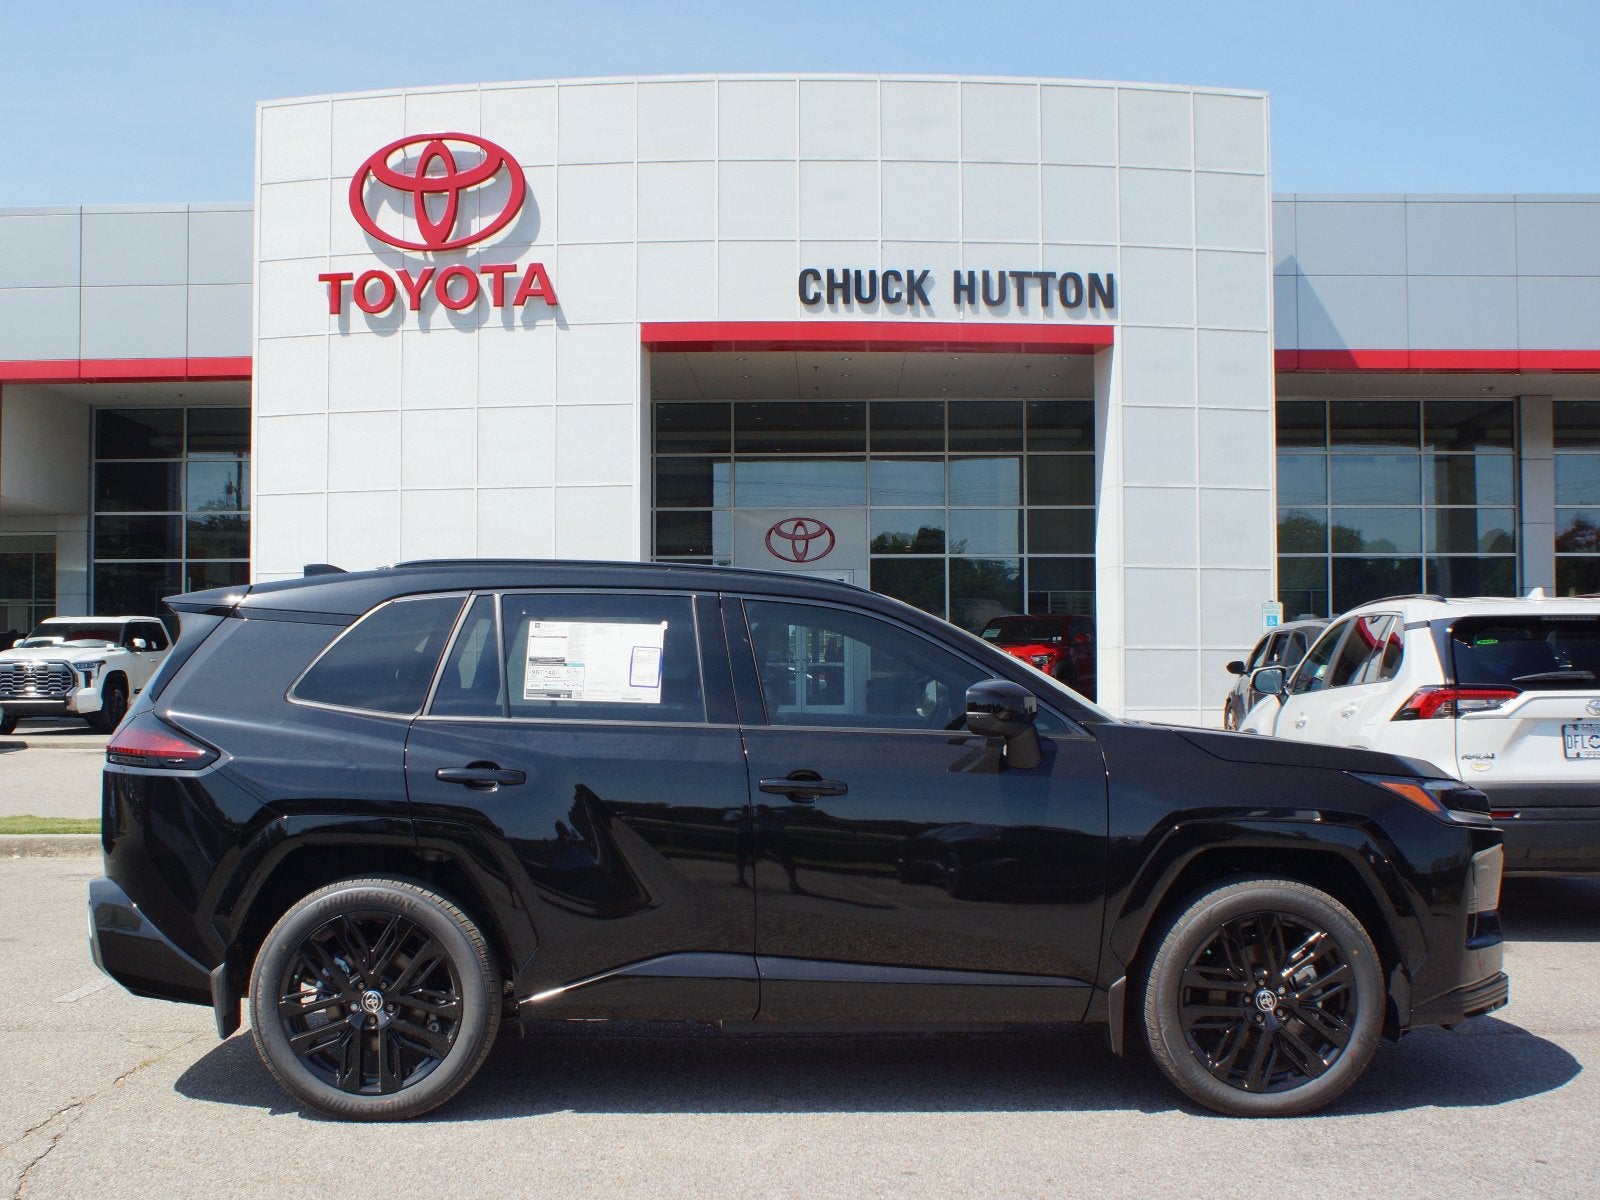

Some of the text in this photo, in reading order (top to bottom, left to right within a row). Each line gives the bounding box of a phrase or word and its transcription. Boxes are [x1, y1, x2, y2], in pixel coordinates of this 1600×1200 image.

[318, 262, 558, 315] TOYOTA
[798, 268, 1115, 309] CHUCK HUTTON
[1566, 734, 1588, 749] DFL
[316, 890, 422, 915] BRIDGESTONE
